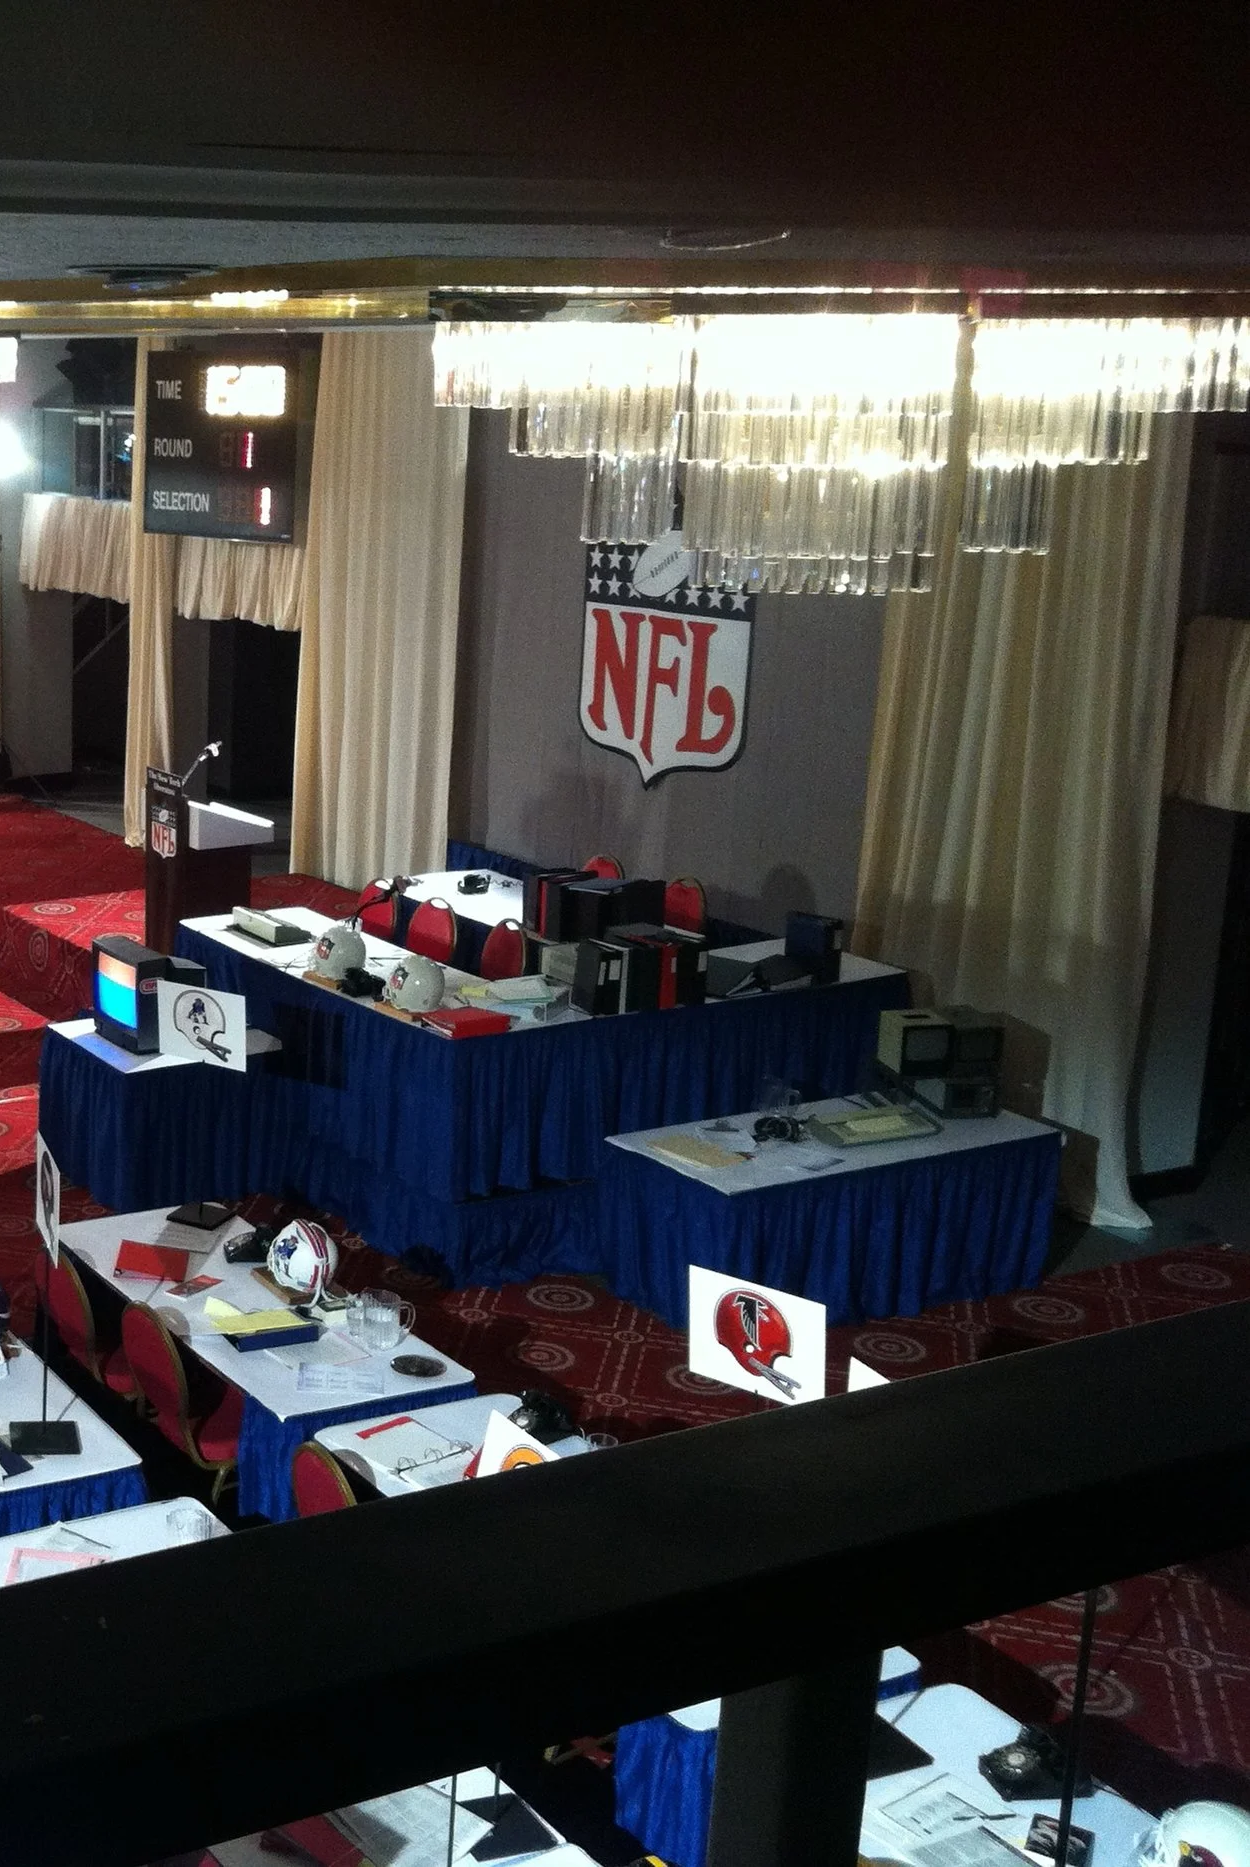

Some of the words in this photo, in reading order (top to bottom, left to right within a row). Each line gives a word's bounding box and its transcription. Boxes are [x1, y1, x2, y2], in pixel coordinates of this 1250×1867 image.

[156, 380, 182, 400] TIME
[153, 438, 192, 457] ROUND
[244, 431, 254, 468] 1
[153, 491, 210, 512] SELECTION
[260, 487, 271, 525] 1
[587, 608, 736, 765] NFL
[153, 822, 174, 855] NFL
